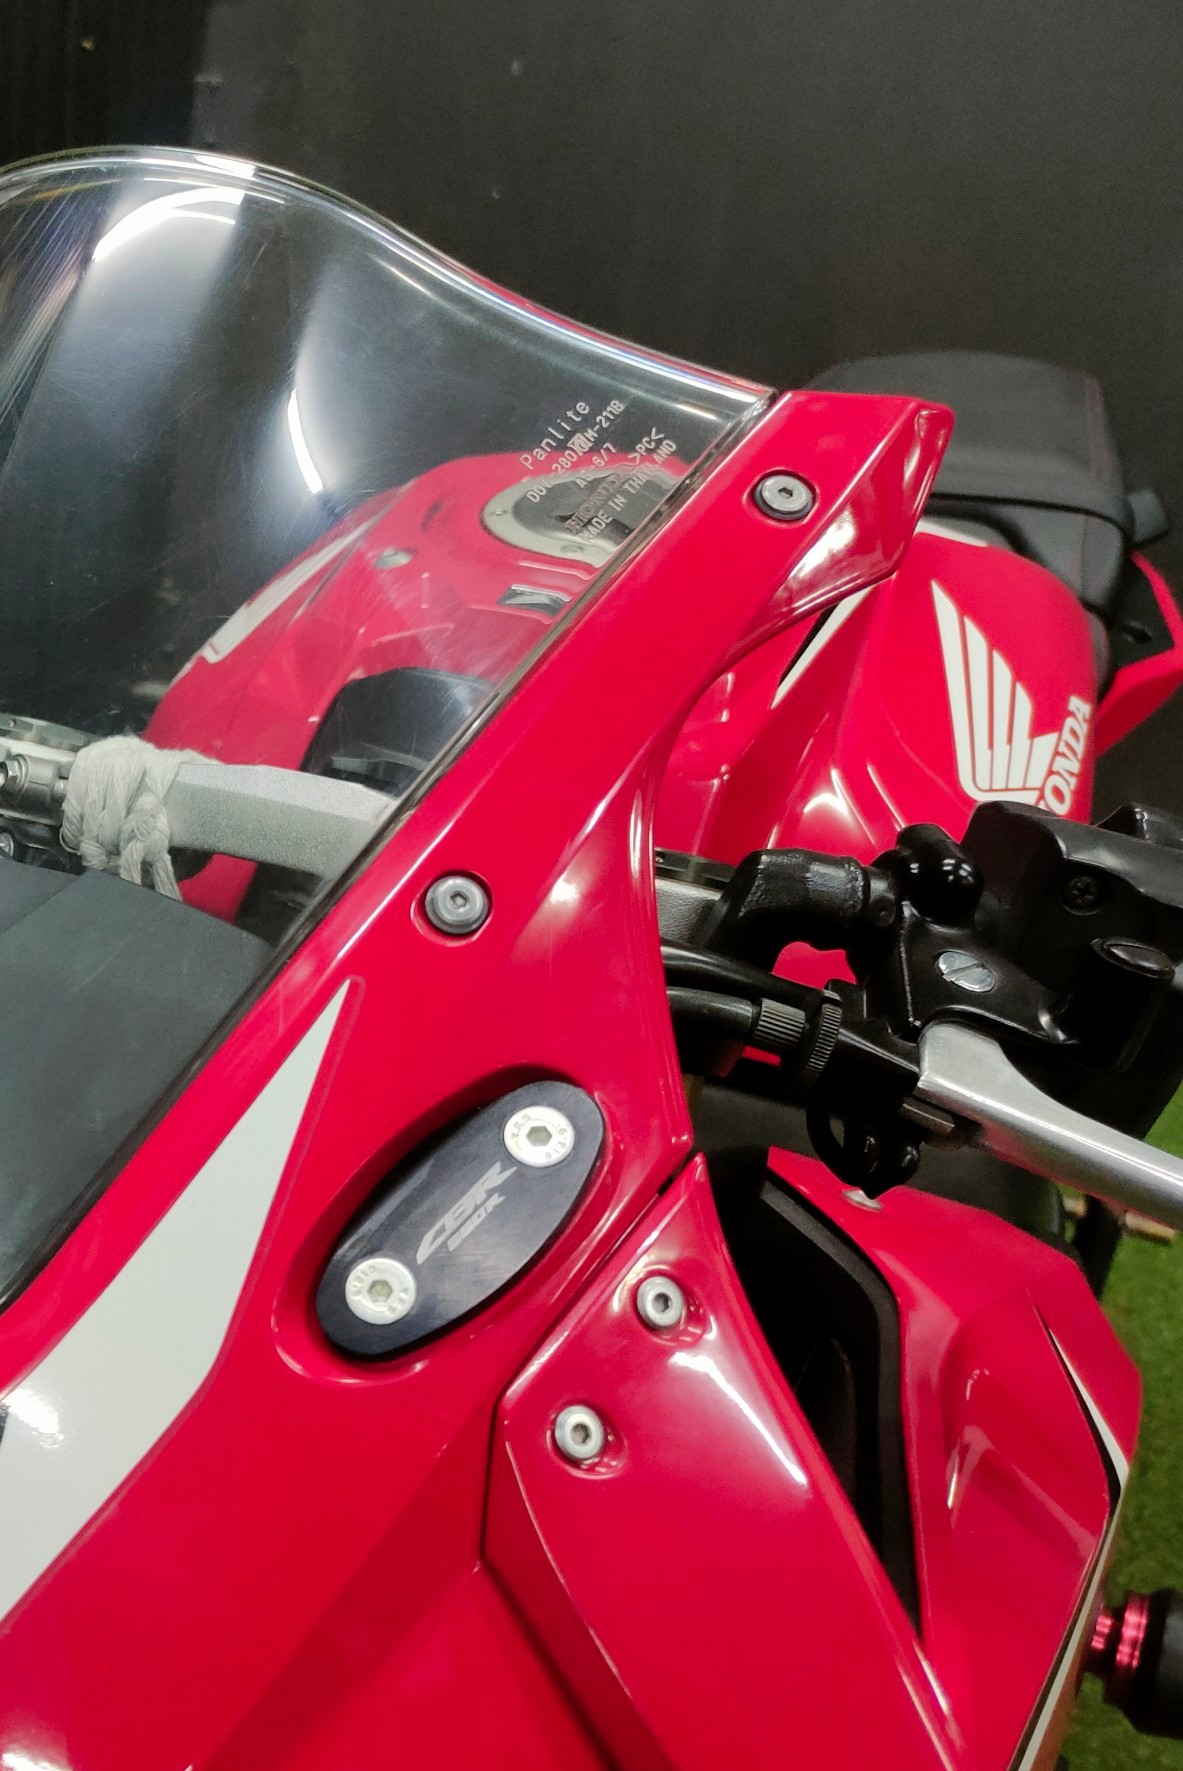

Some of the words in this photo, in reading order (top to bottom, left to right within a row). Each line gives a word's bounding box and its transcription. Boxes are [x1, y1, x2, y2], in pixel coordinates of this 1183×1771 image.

[520, 401, 590, 470] Panlite
[578, 510, 613, 543] MADE
[608, 494, 627, 512] IN
[1040, 695, 1092, 816] ONDA
[415, 1161, 518, 1266] CBR
